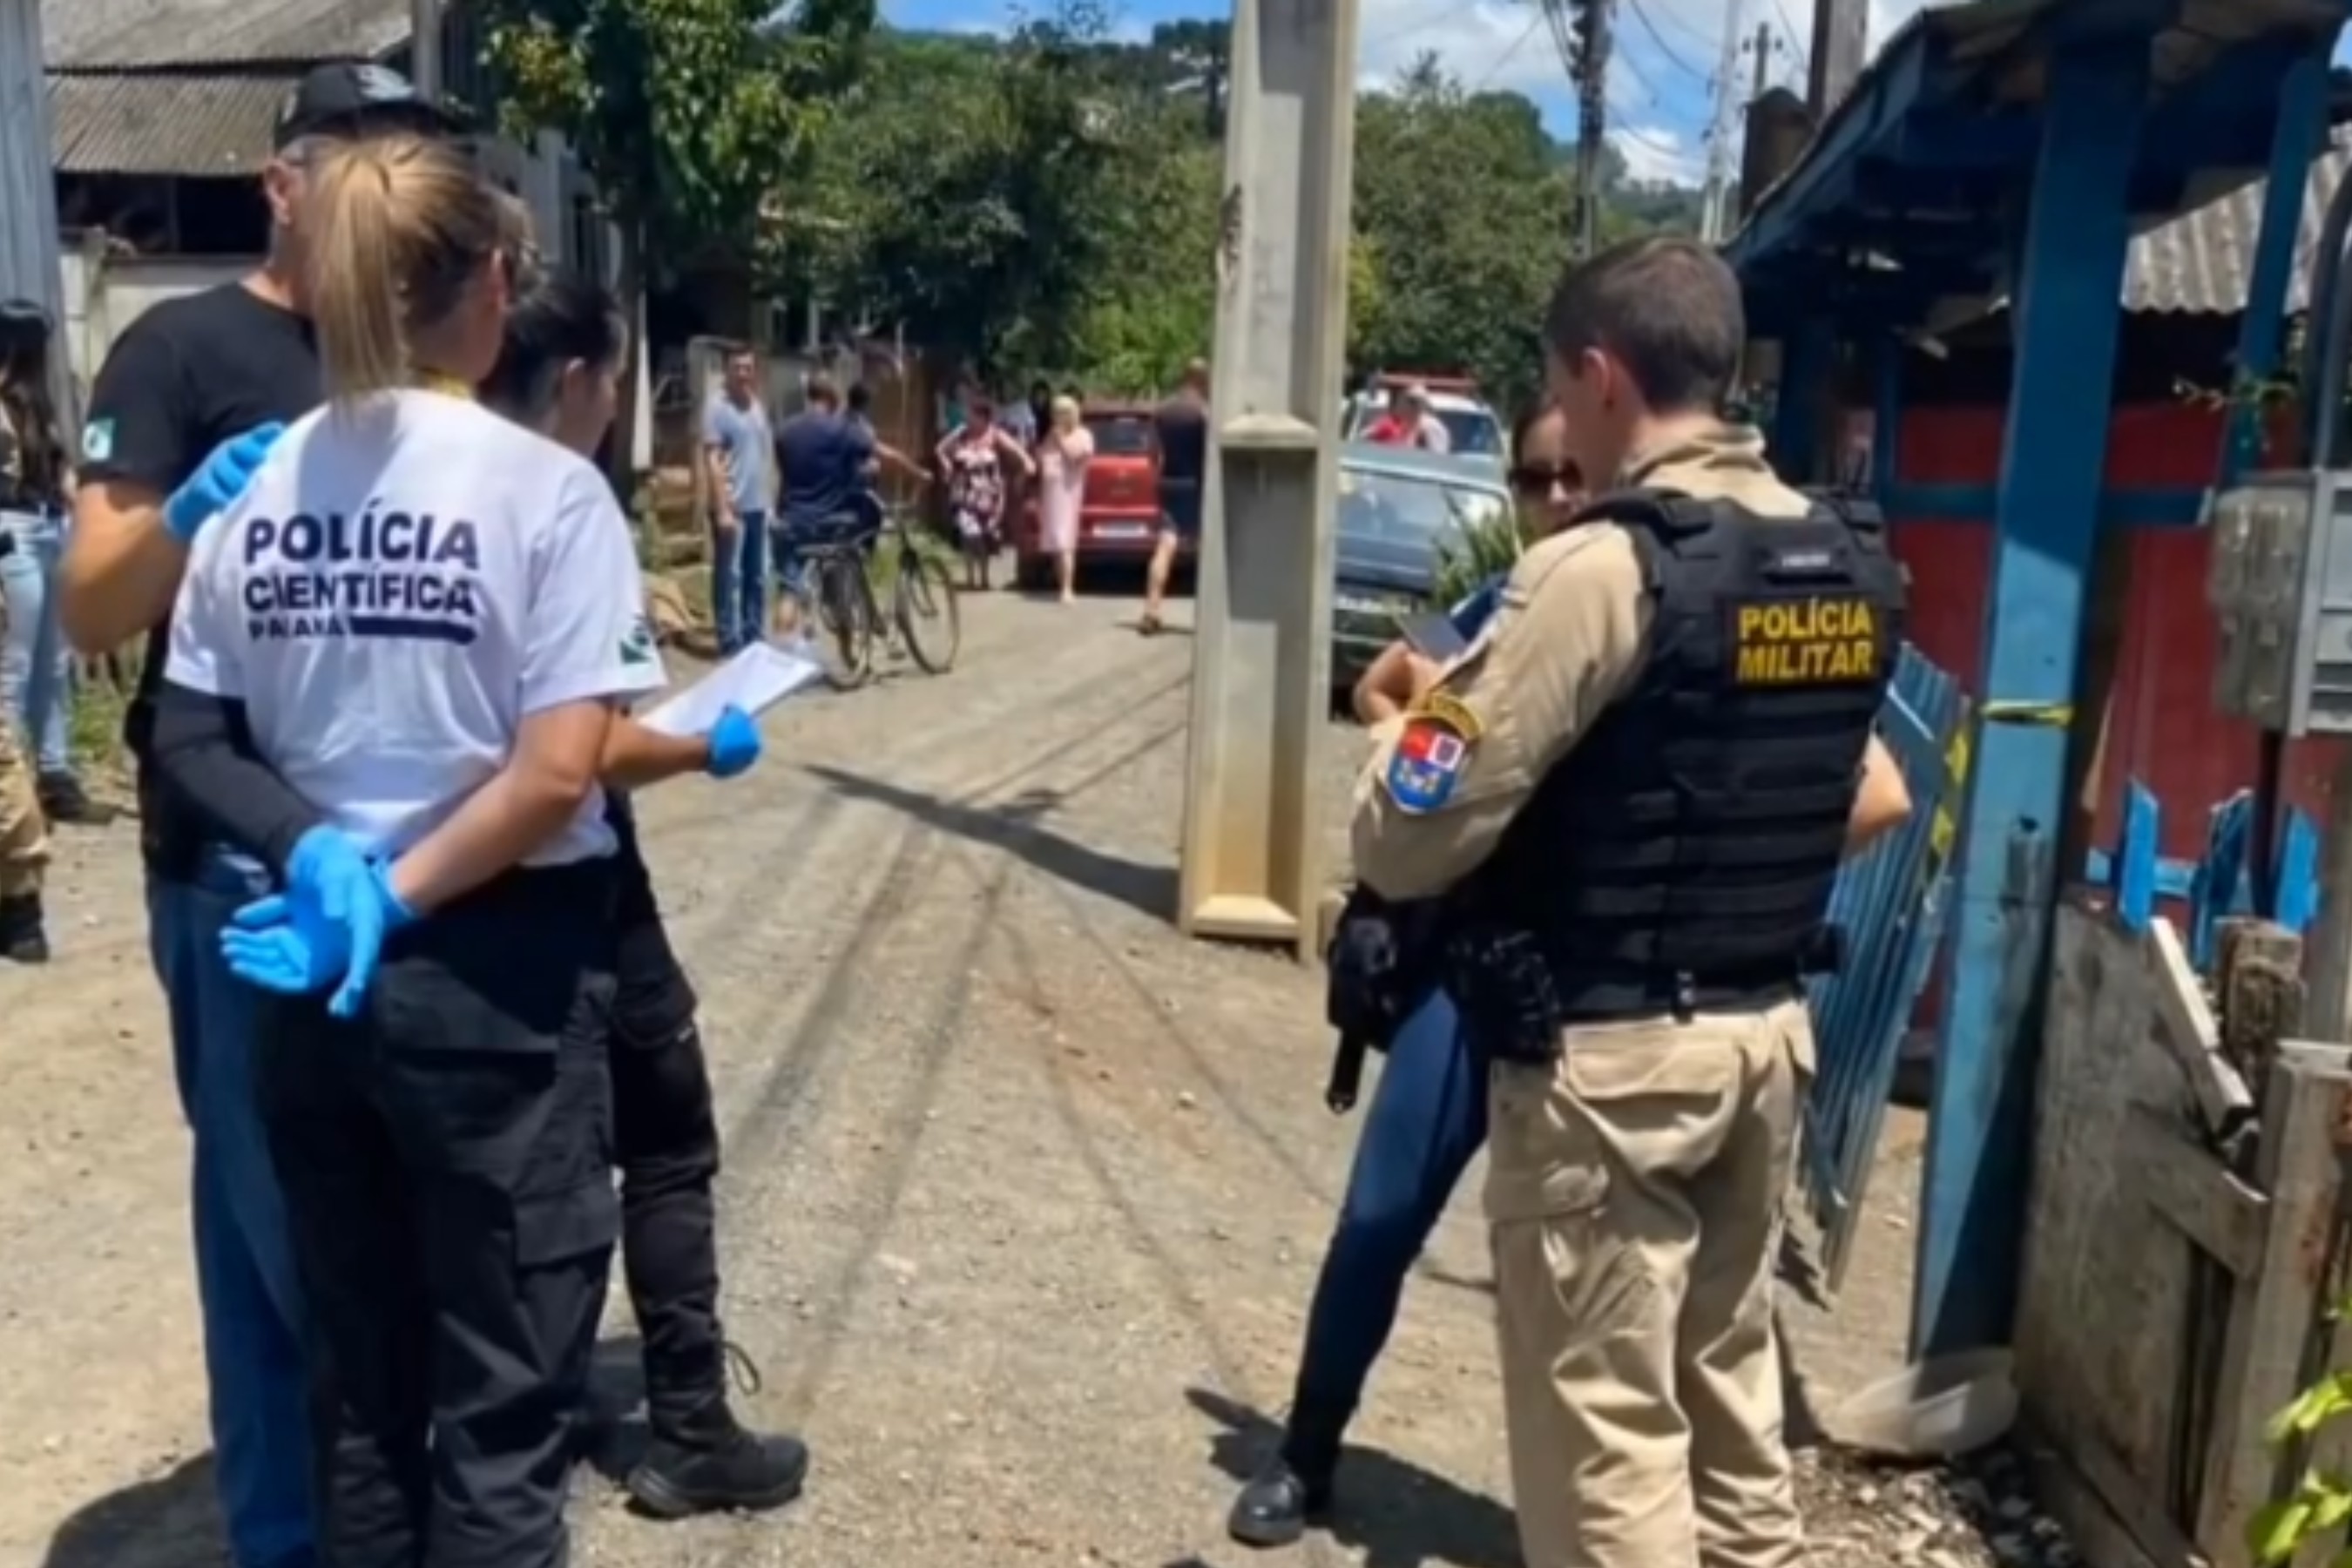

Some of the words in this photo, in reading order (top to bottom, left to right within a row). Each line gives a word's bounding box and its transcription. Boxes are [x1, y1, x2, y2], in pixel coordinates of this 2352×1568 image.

[245, 497, 478, 570] POLÍCIA
[1740, 594, 1872, 640] POLÍCIA
[1738, 640, 1873, 682] MILITAR
